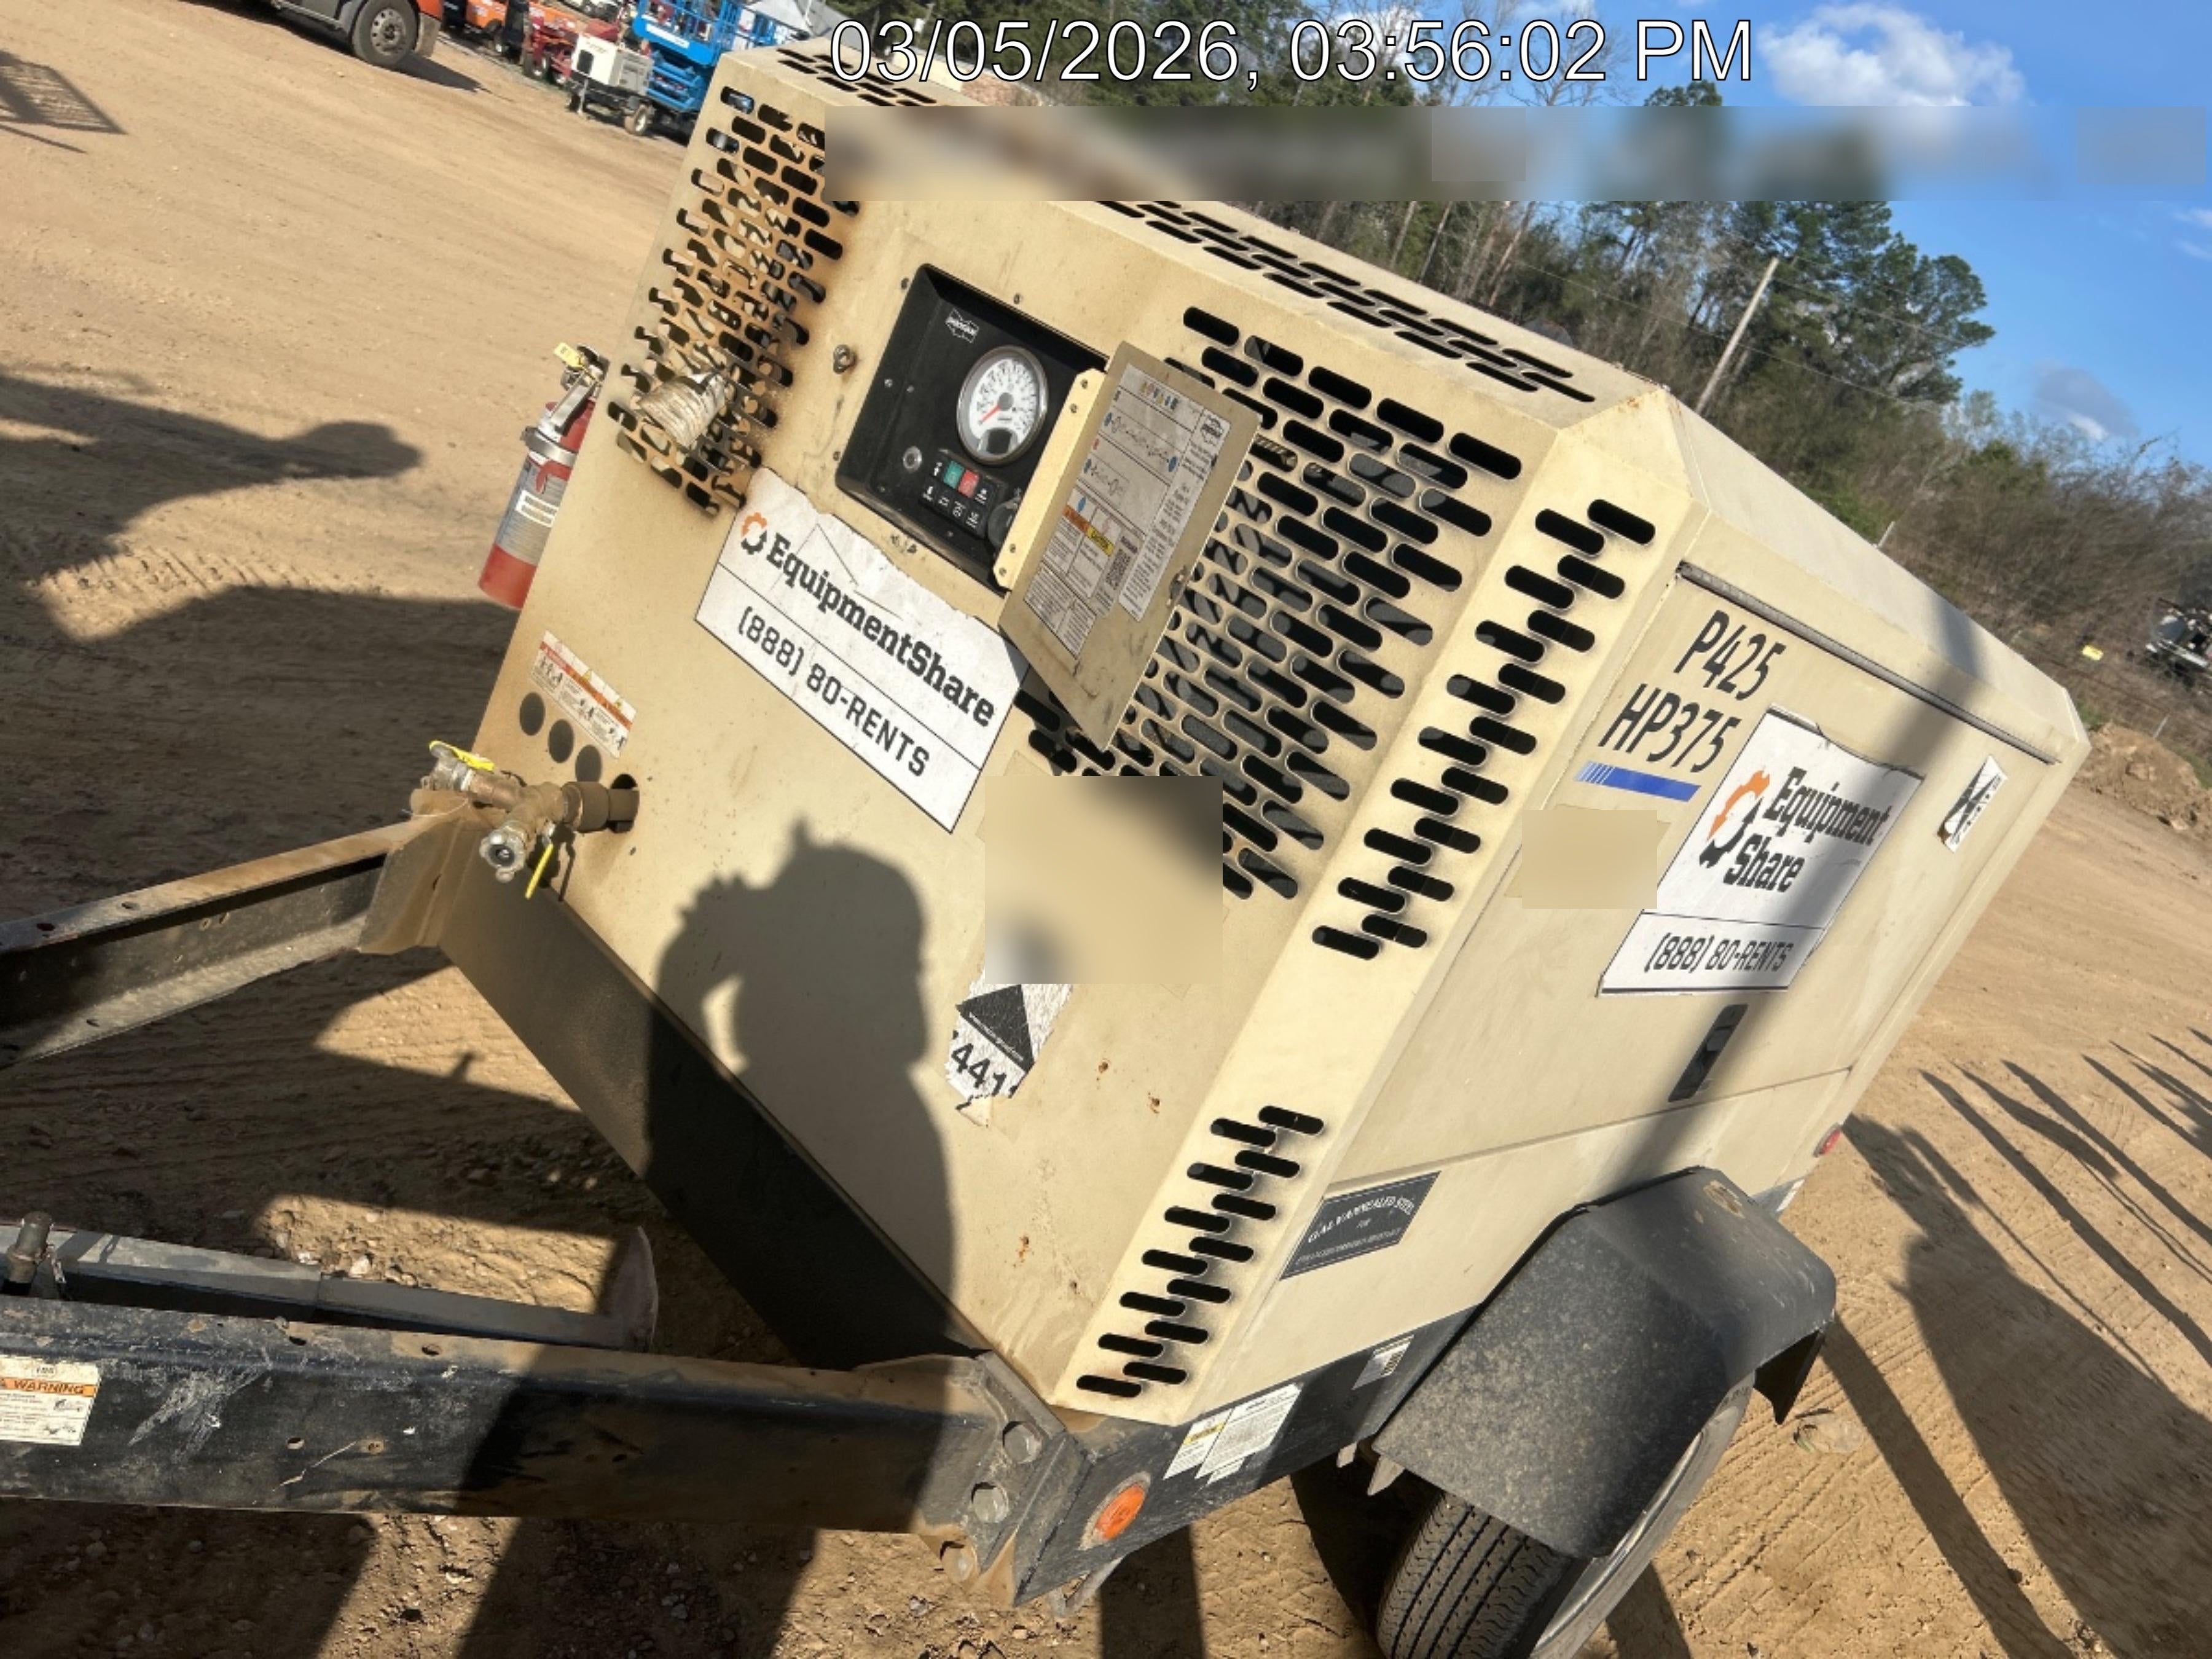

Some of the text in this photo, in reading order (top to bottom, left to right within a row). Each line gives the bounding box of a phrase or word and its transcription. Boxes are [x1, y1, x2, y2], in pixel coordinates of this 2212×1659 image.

[766, 532, 995, 728] EquipmentShare
[1674, 610, 1786, 701] P425
[739, 606, 929, 777] (888) 80-RENTS
[1599, 683, 1742, 774] HP375
[1763, 767, 1892, 847] Equipment
[1724, 833, 1805, 893] Share
[1644, 931, 1794, 973] (888) 80-RENTS
[14, 1380, 84, 1394] WARNING
